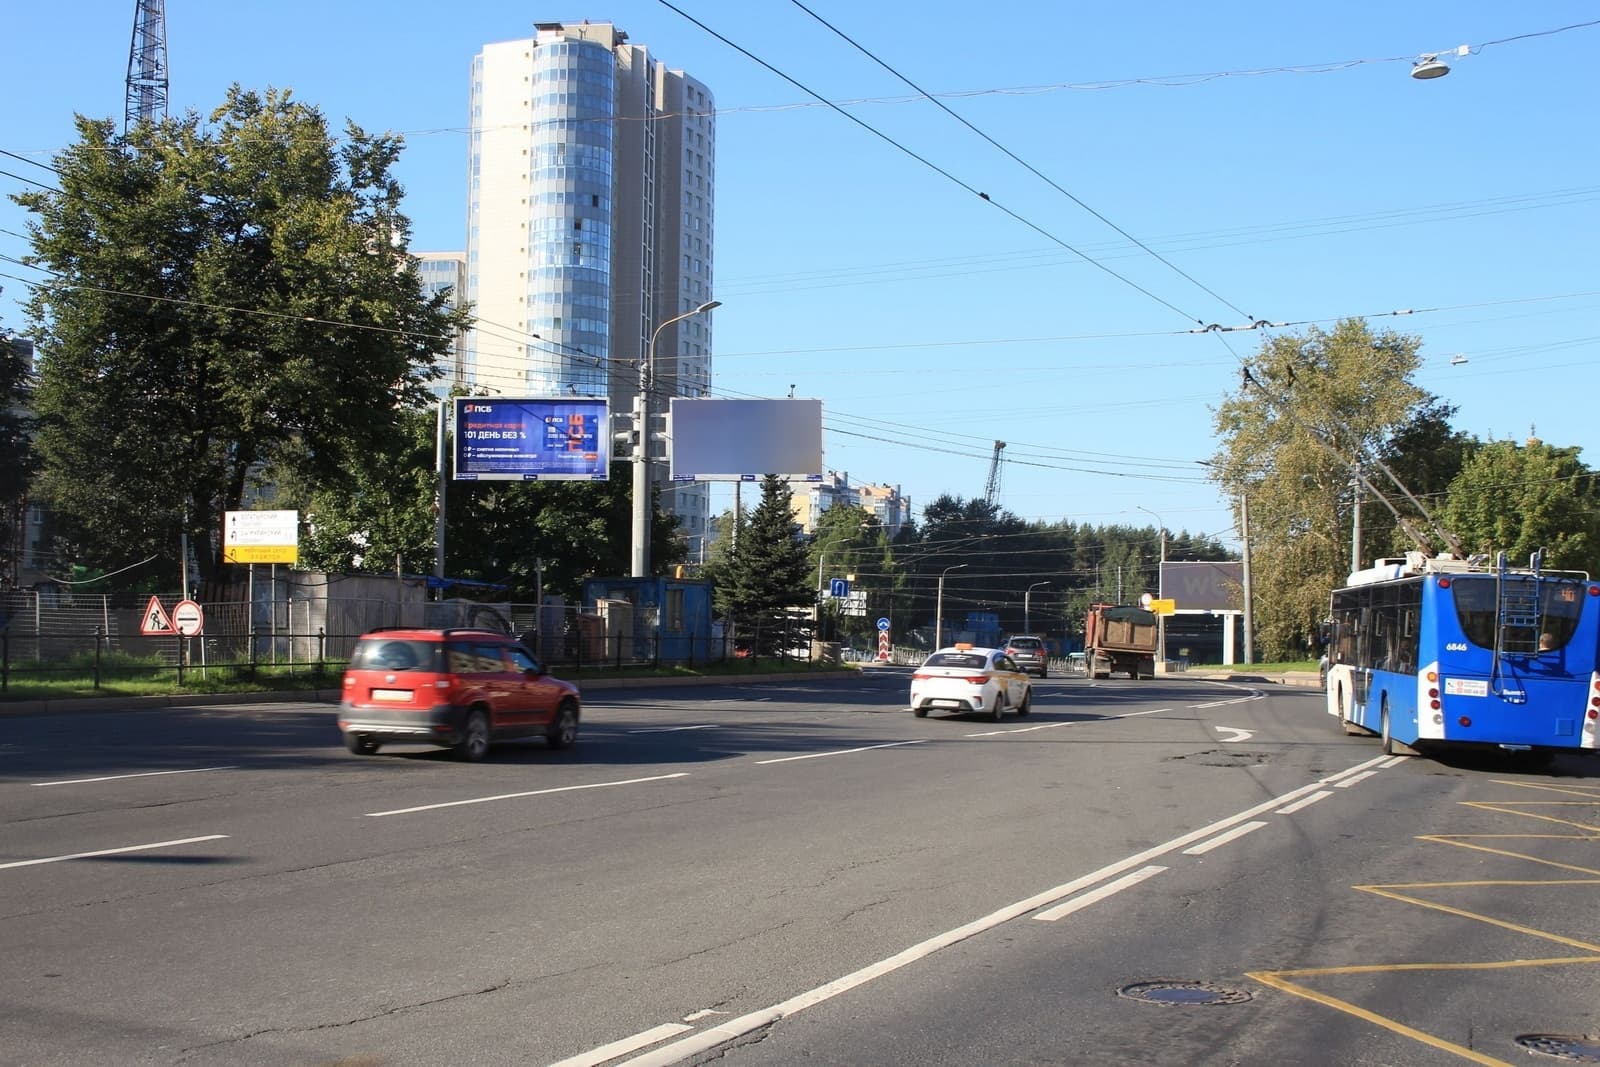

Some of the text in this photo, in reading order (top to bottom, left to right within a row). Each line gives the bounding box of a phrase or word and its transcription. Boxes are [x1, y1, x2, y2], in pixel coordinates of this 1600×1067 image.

[464, 431, 527, 440] 101 ДЕНЬ БЕЗ %
[1446, 642, 1468, 652] 6846
